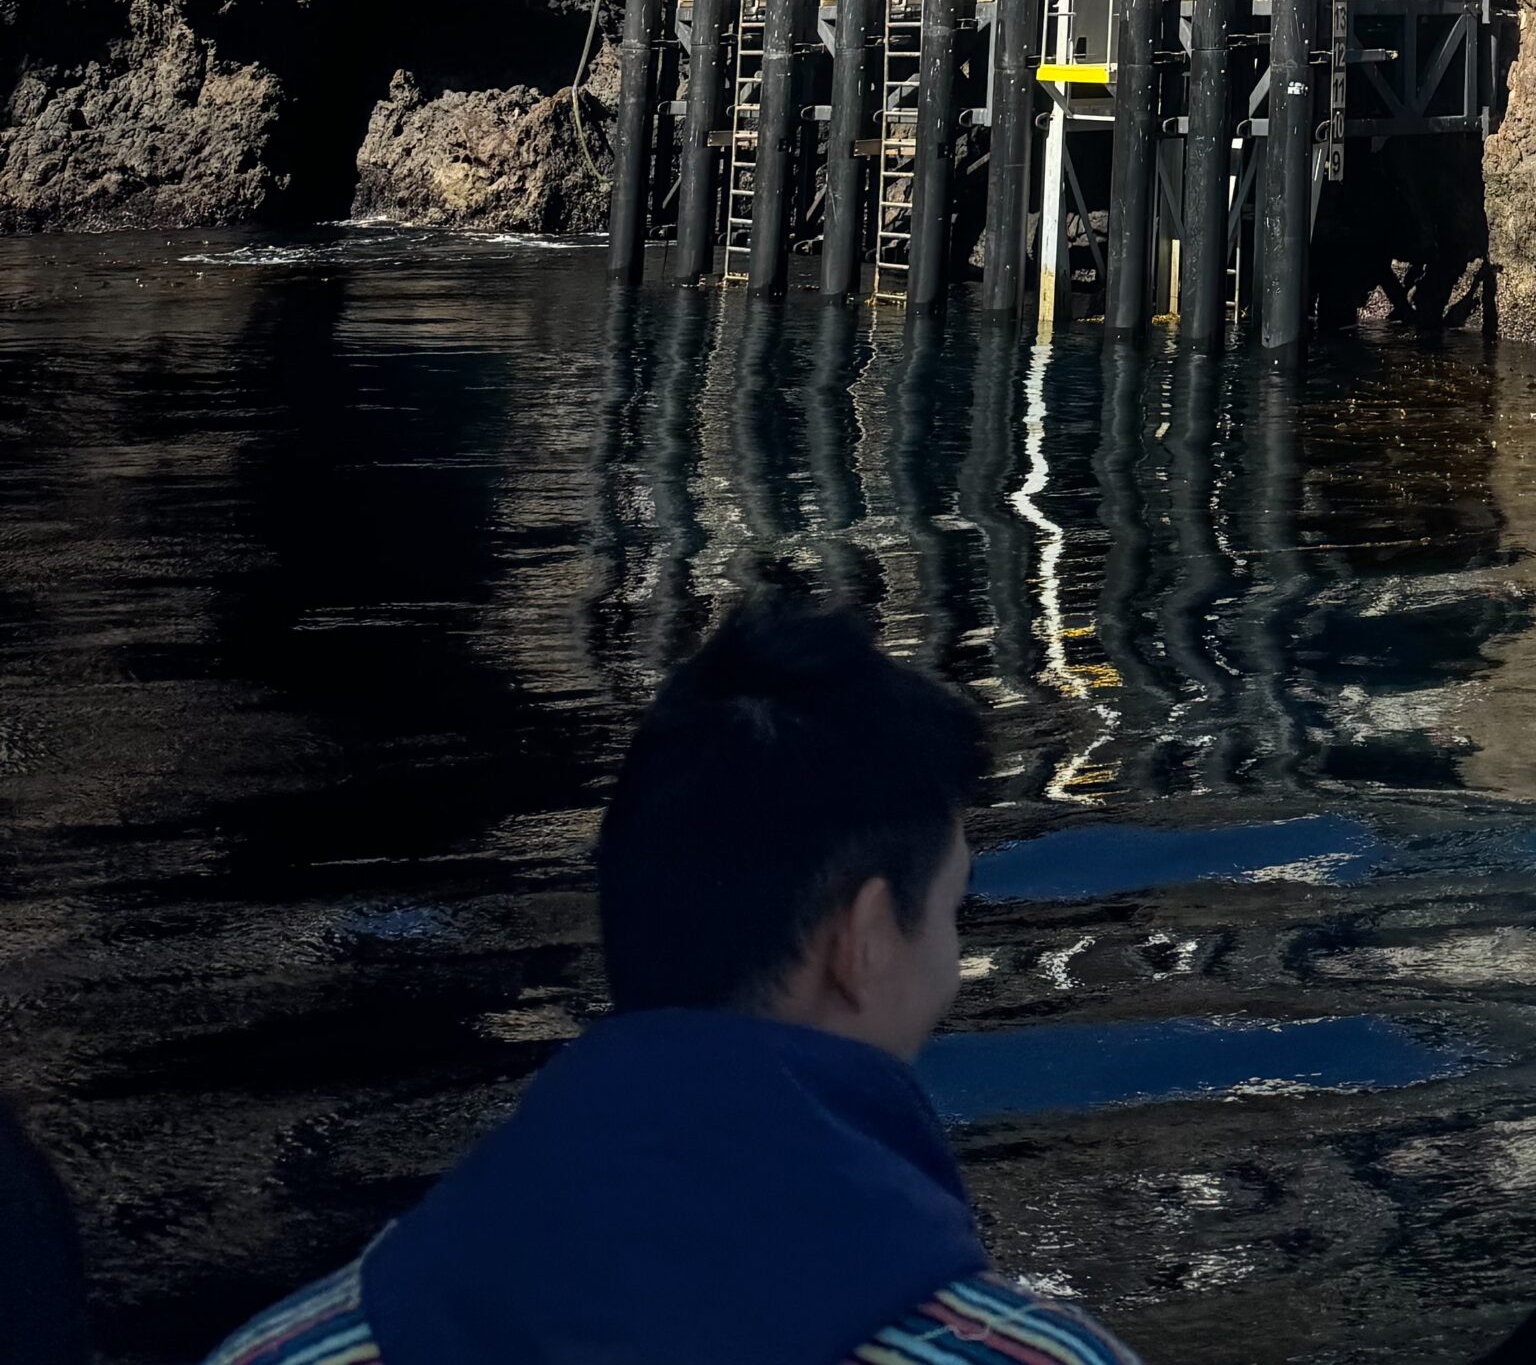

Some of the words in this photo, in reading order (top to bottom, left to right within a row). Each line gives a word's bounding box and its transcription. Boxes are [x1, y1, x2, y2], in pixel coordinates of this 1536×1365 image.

[1335, 7, 1346, 31] 13
[1335, 42, 1346, 67] 12
[1333, 77, 1345, 103] 11
[1332, 114, 1344, 139] 10
[1332, 151, 1341, 176] 9
